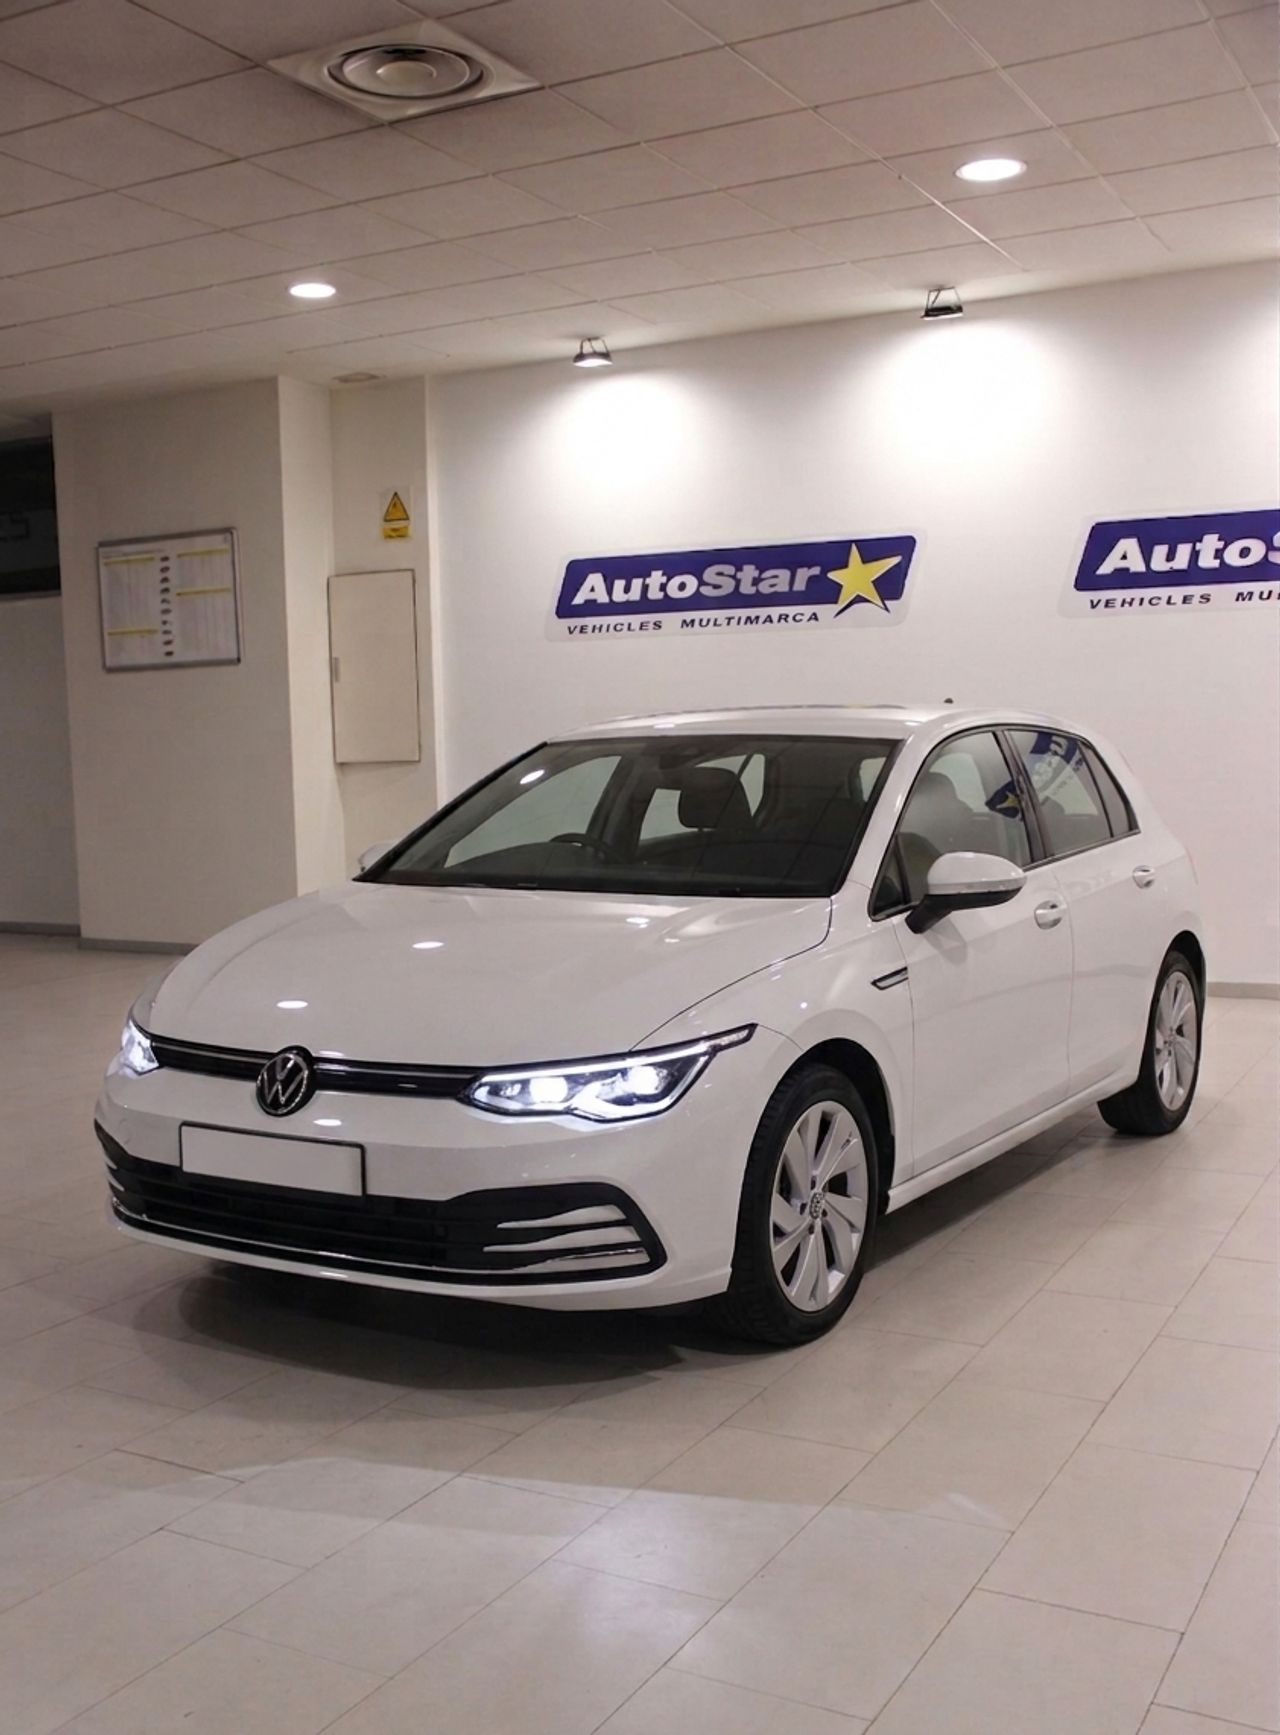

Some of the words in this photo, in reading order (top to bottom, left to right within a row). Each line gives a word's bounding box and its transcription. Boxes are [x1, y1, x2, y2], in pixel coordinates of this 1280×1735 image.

[1095, 530, 1280, 575] Auto
[571, 564, 821, 605] AutoStar
[1089, 593, 1212, 609] VEHICLES
[1235, 589, 1280, 602] MU
[567, 620, 663, 635] VEHICLES
[680, 612, 819, 629] MULTIMARCA
